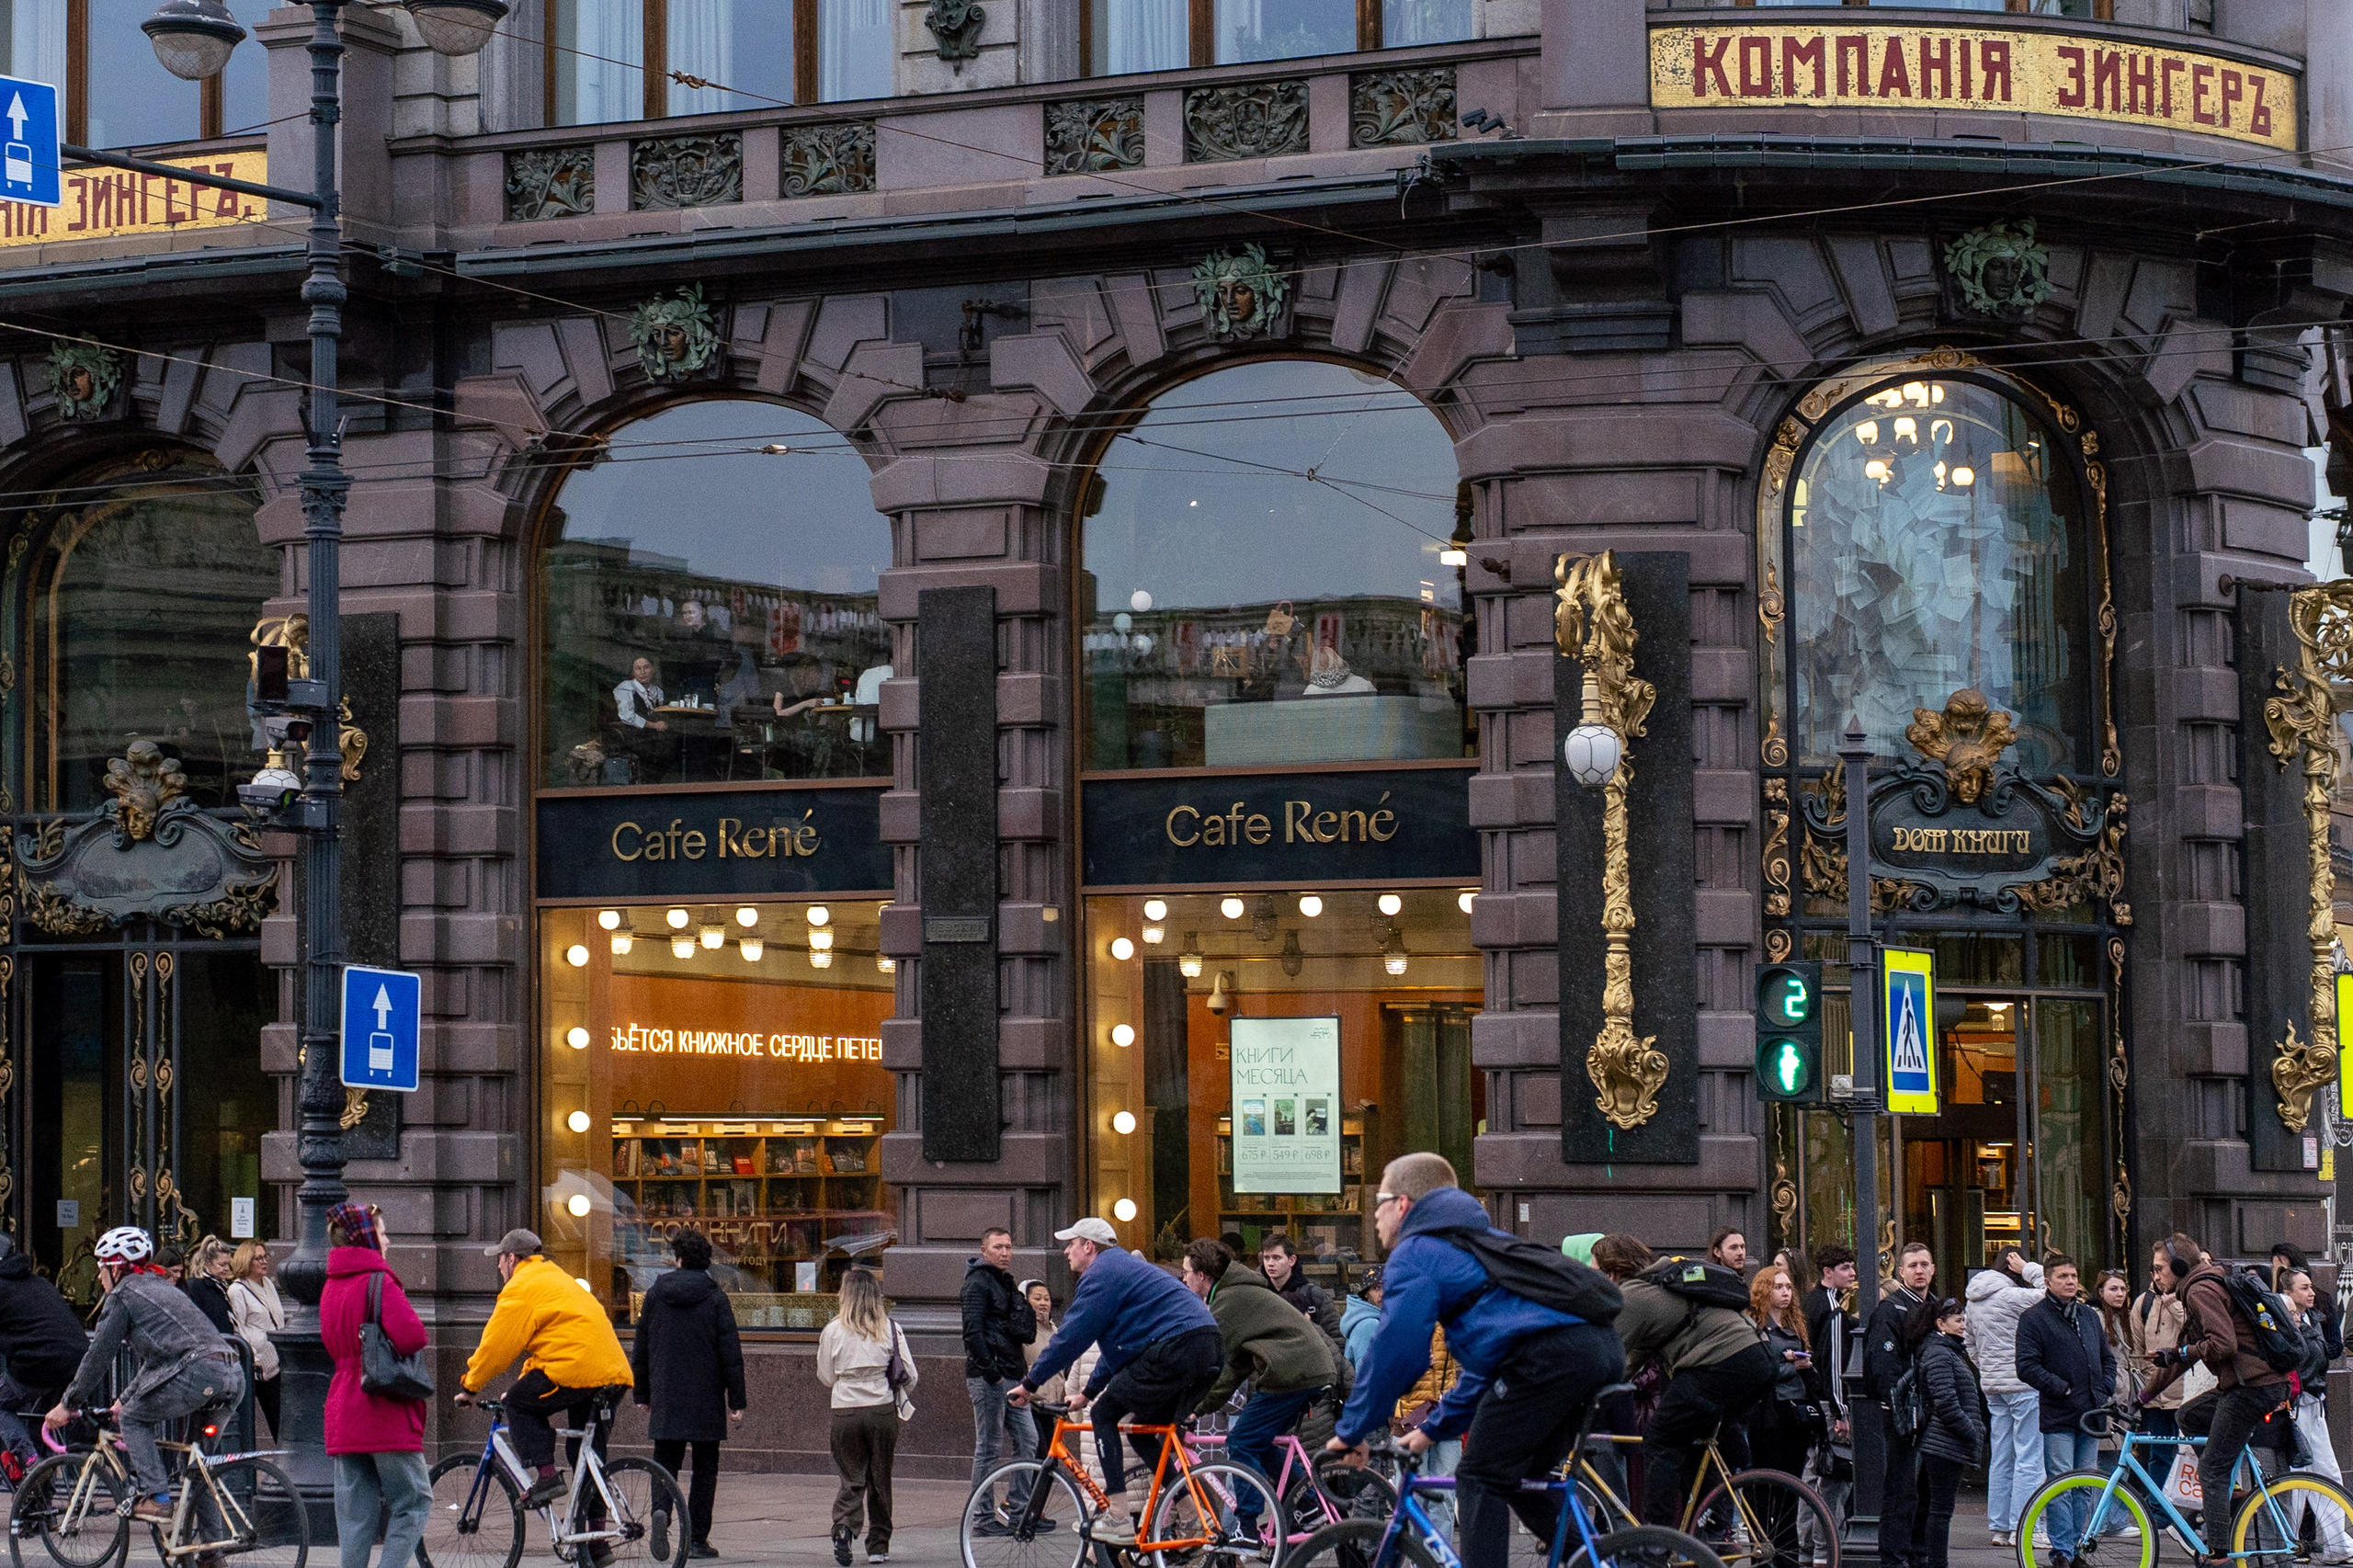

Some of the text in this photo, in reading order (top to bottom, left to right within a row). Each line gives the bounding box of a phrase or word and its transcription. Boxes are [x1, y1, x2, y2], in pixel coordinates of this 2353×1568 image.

[1693, 36, 2272, 137] КОМПАНІЯ ЗИНГЕРЪ
[1166, 790, 1399, 847] Cafe René
[611, 808, 822, 861] Cafe René
[1784, 979, 1807, 1017] 2
[678, 1030, 765, 1056] КНИЖНОЕ
[769, 1034, 834, 1062] СЕРДЦЕ
[836, 1037, 882, 1060] ПЕТЕ
[1236, 1048, 1293, 1063] КНИГИ
[1236, 1068, 1309, 1086] МЕСЯЦА
[1242, 1150, 1259, 1160] 675
[1272, 1150, 1290, 1160] 549
[1305, 1150, 1323, 1160] 698
[743, 1256, 768, 1266] ГОДУ
